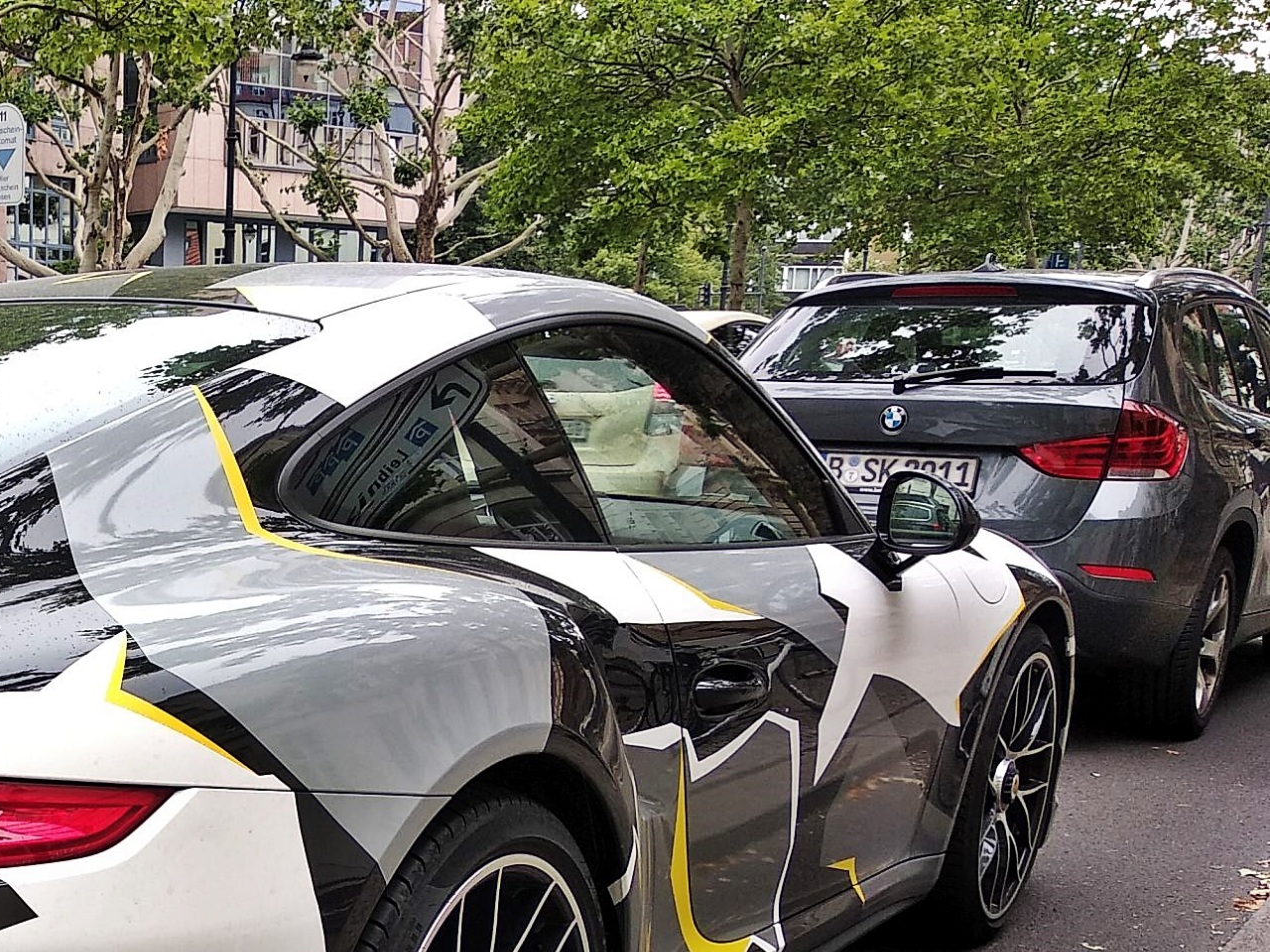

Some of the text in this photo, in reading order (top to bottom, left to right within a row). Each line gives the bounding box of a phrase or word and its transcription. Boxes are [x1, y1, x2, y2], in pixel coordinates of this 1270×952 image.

[0, 111, 8, 122] 11
[830, 456, 845, 480] B
[861, 457, 899, 482] SK
